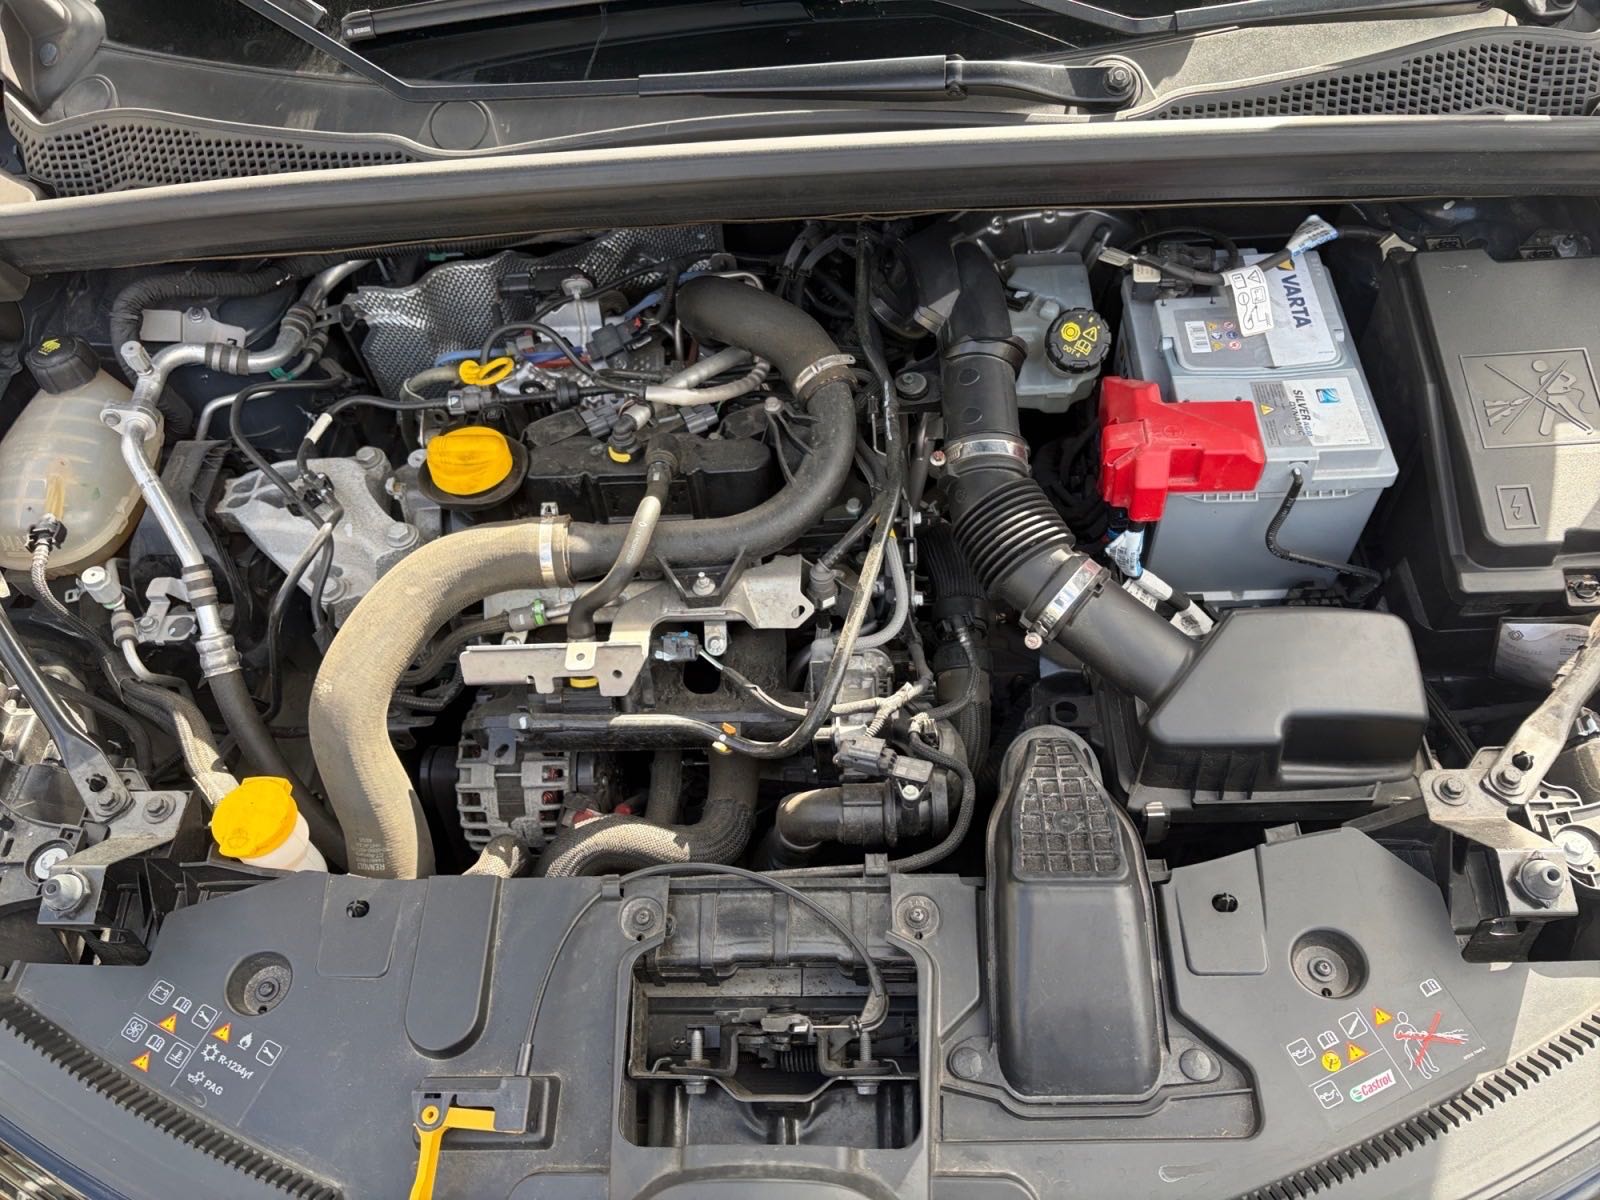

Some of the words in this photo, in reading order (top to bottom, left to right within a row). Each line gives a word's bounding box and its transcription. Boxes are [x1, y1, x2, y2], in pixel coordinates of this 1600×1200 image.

[1281, 274, 1312, 328] VARTA
[1062, 344, 1077, 355] DOT
[1293, 389, 1312, 421] SILVER
[1288, 401, 1306, 436] DYNAMIC
[217, 1054, 254, 1080] R-1234yf
[203, 1079, 224, 1096] PAG
[1361, 1073, 1393, 1096] Castrol
